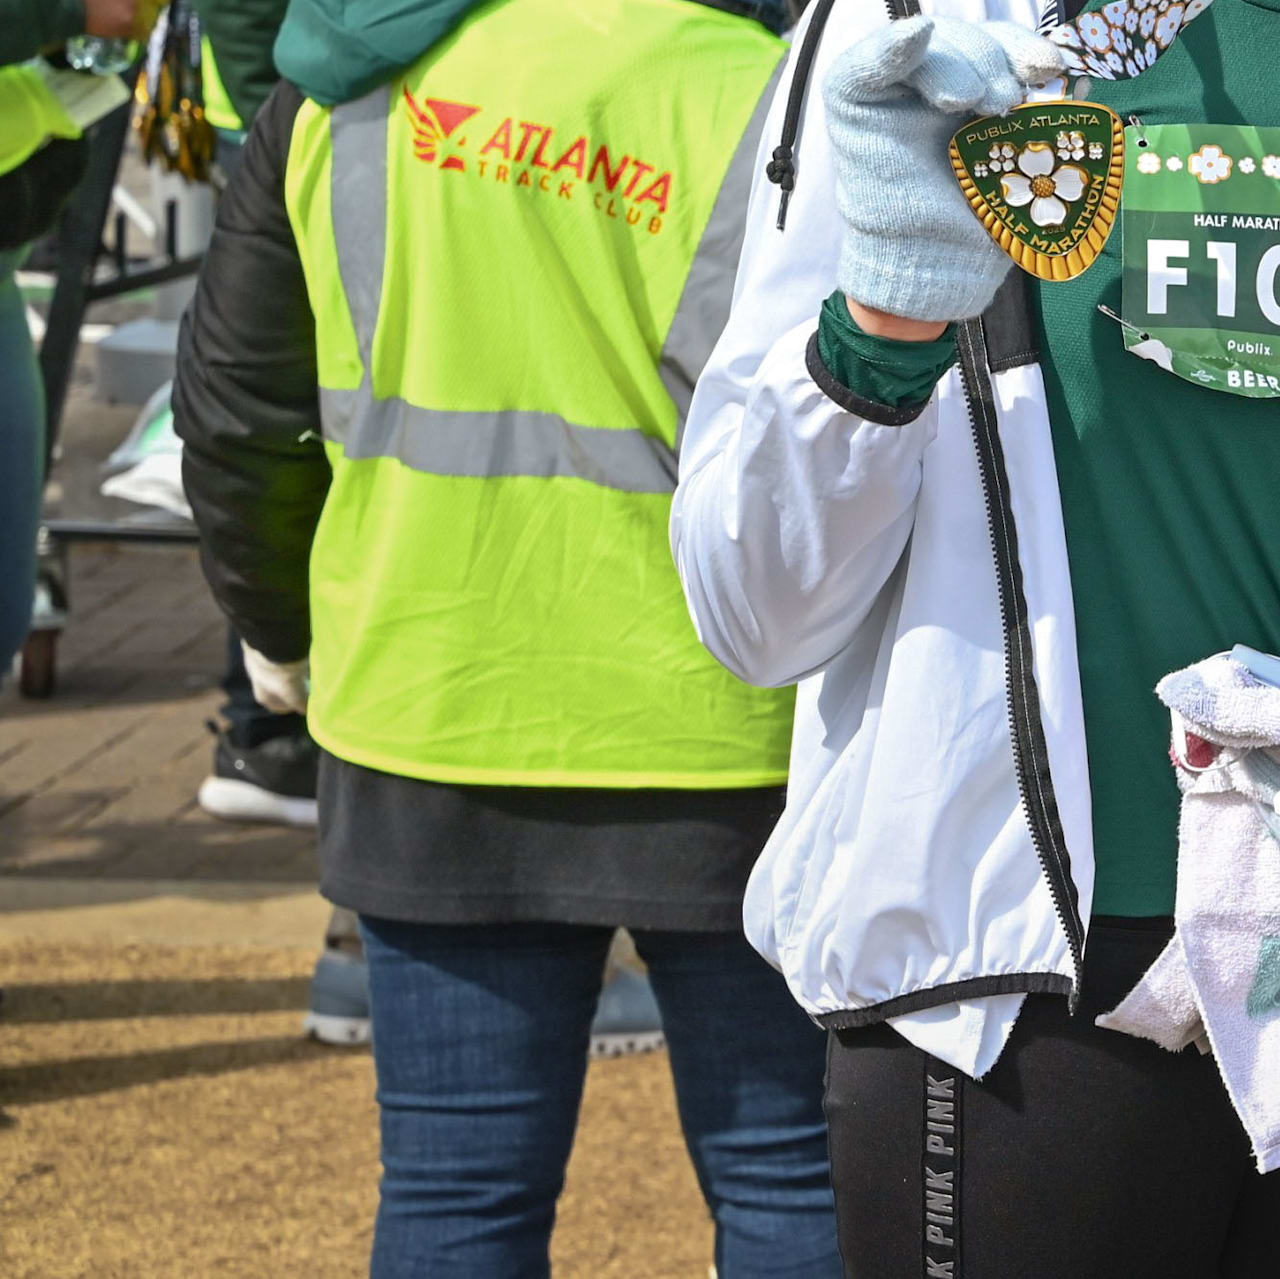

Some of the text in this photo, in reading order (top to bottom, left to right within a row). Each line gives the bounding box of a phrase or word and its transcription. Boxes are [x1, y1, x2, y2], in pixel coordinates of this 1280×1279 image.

[480, 117, 672, 213] ATLANTA
[966, 113, 1100, 145] PUBLIX ATLANTA
[478, 160, 663, 234] TRACK CLUB
[986, 174, 1105, 254] HALF MARATHON
[1193, 214, 1227, 227] HALF
[1227, 370, 1280, 392] BEER
[926, 1074, 955, 1156] PINK
[926, 1166, 954, 1246] PINK
